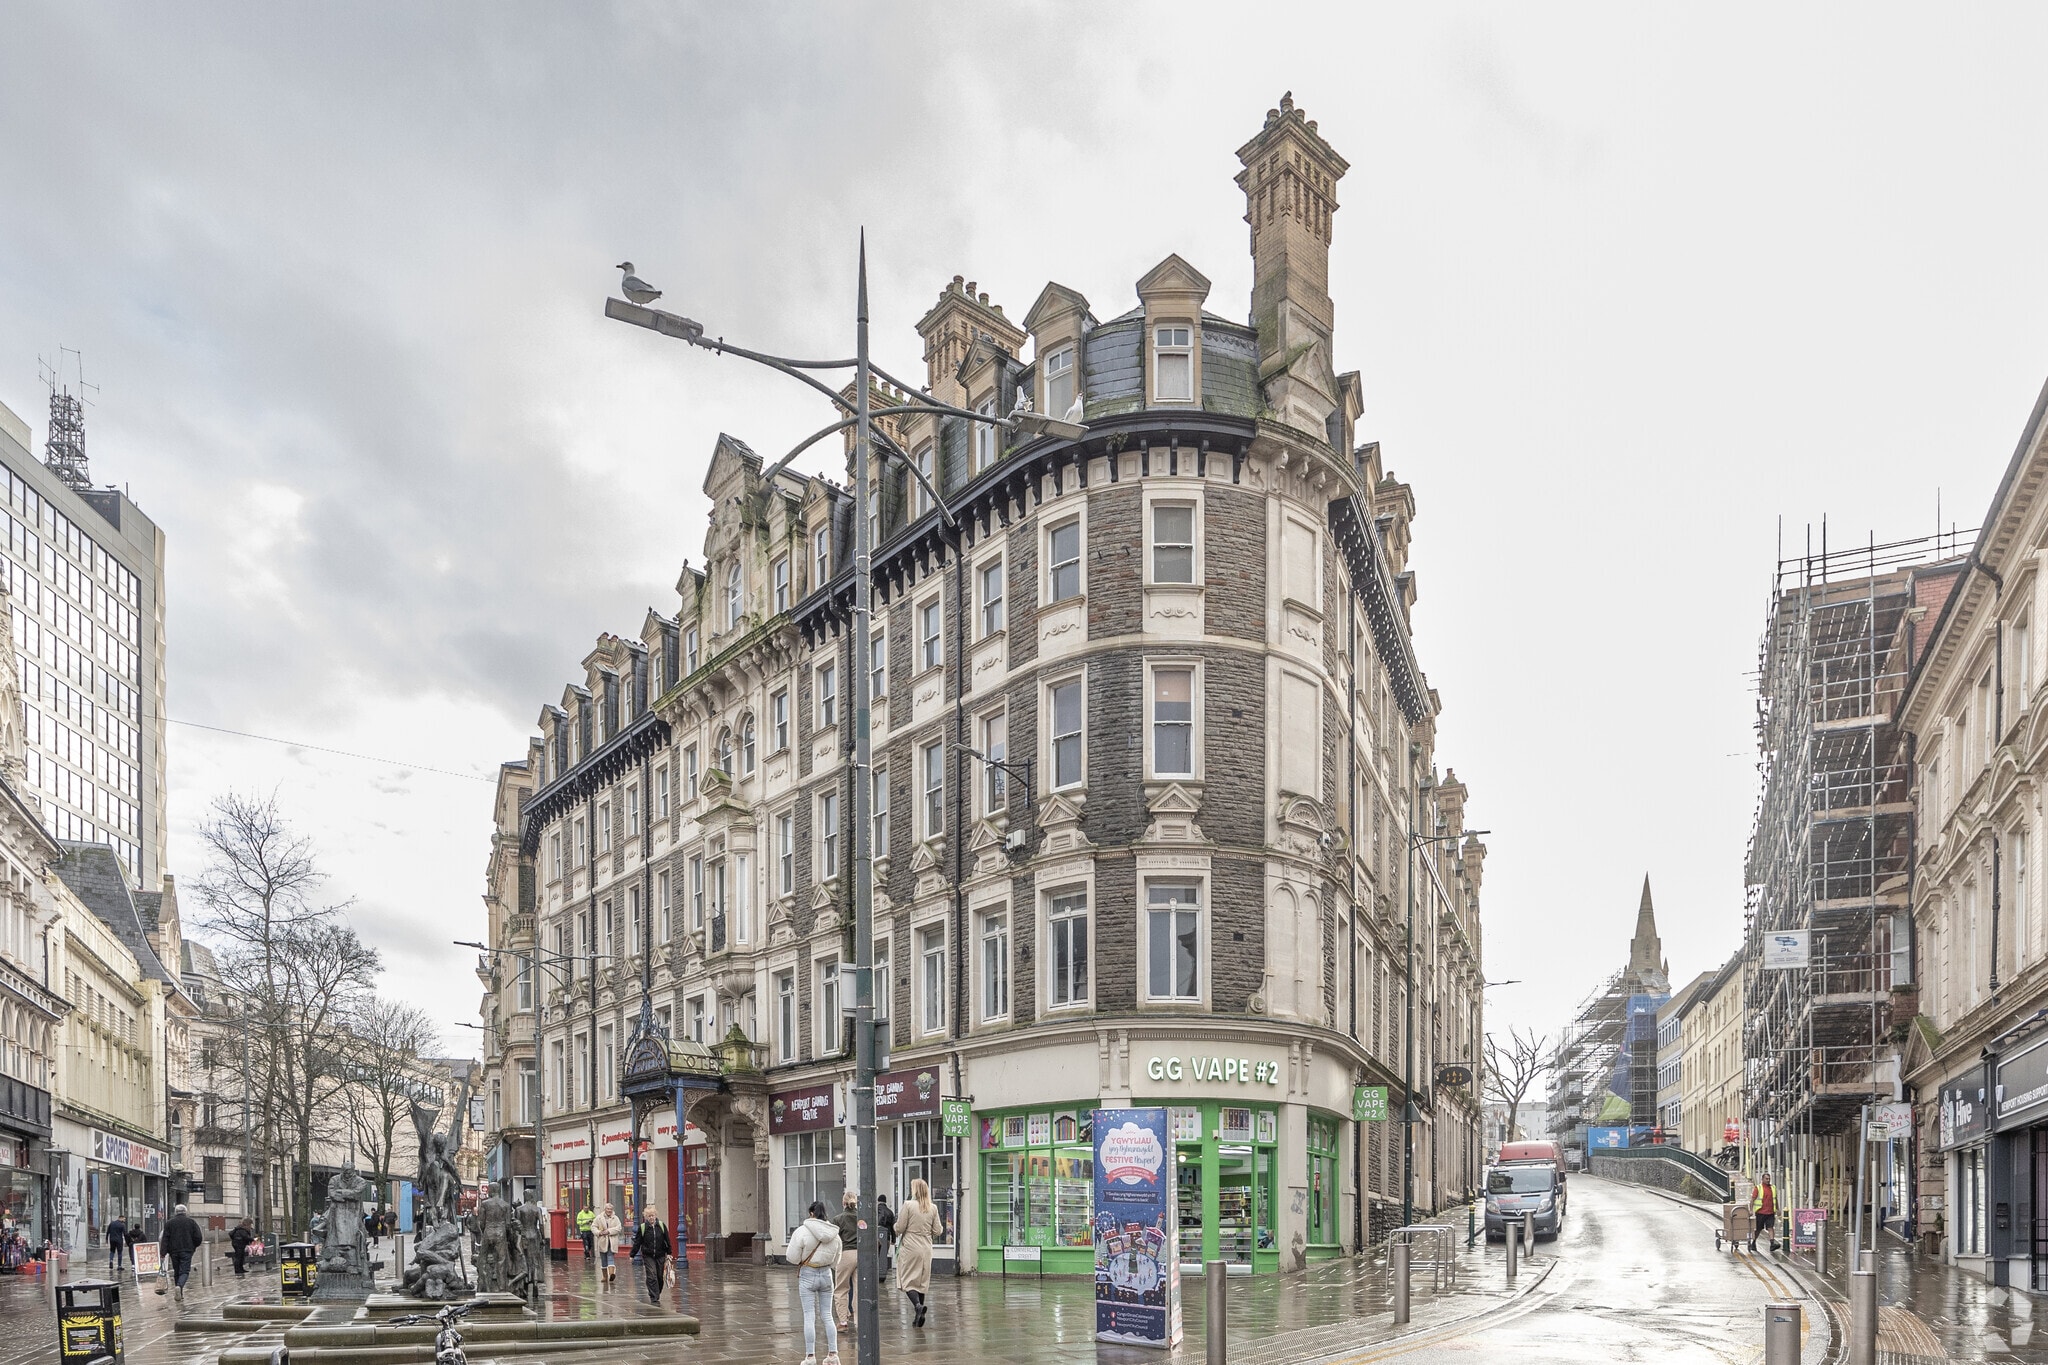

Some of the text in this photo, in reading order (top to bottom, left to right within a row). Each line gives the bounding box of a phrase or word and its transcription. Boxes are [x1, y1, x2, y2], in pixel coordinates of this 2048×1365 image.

[1147, 1056, 1279, 1084] GG VAPE #2
[1362, 1089, 1379, 1098] GG
[1357, 1099, 1385, 1108] VAPE
[949, 1104, 963, 1113] GG
[1364, 1109, 1377, 1118] #2
[945, 1114, 968, 1124] VAPE
[951, 1125, 962, 1134] #2
